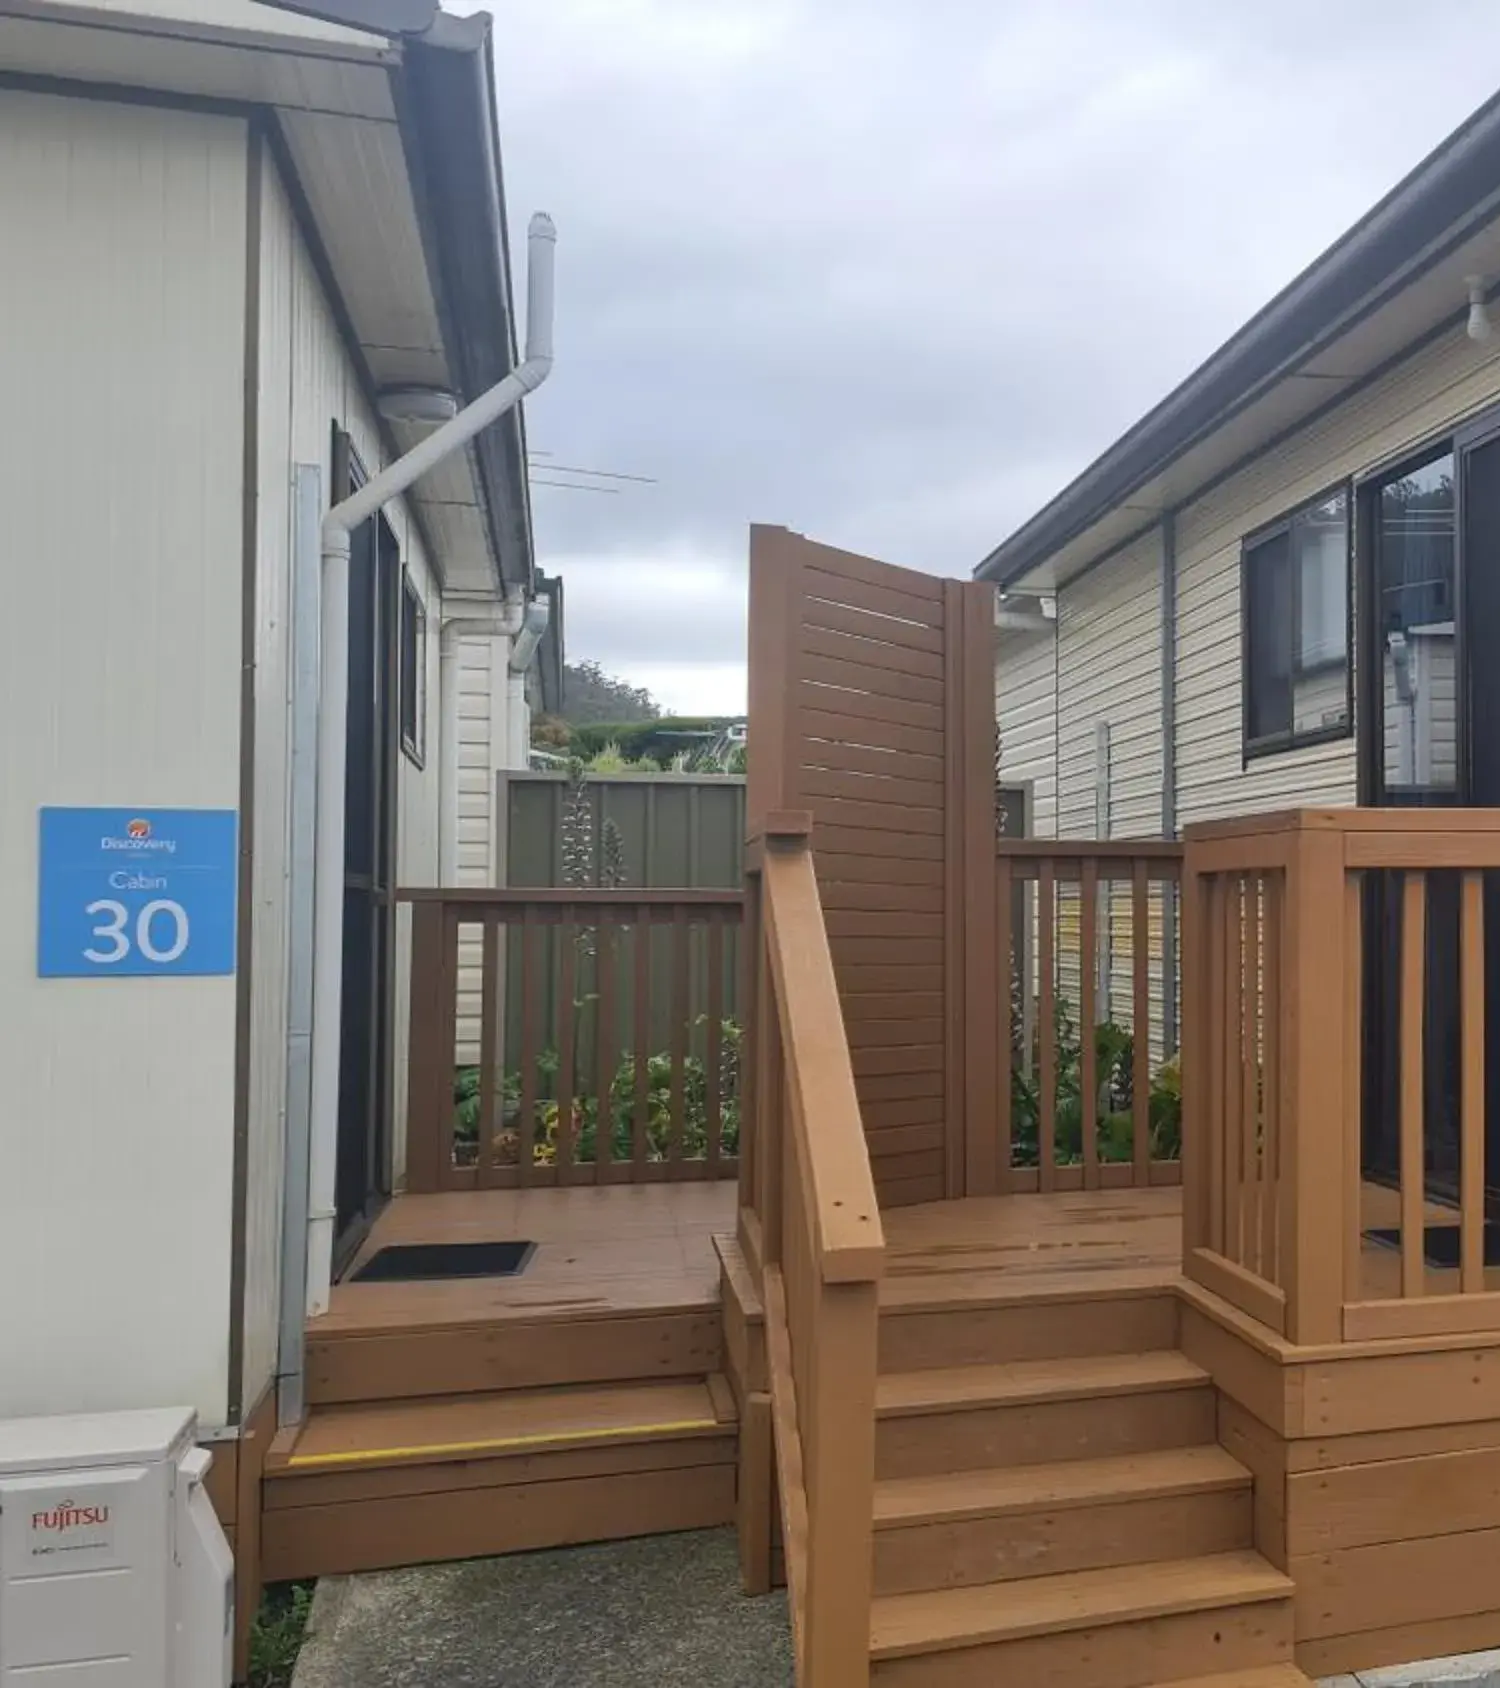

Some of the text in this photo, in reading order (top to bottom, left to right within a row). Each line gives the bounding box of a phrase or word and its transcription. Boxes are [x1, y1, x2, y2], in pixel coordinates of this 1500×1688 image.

[101, 836, 176, 853] Discovery
[109, 871, 167, 890] Cabin
[83, 899, 189, 963] 30
[32, 1504, 109, 1531] FUJITSU
